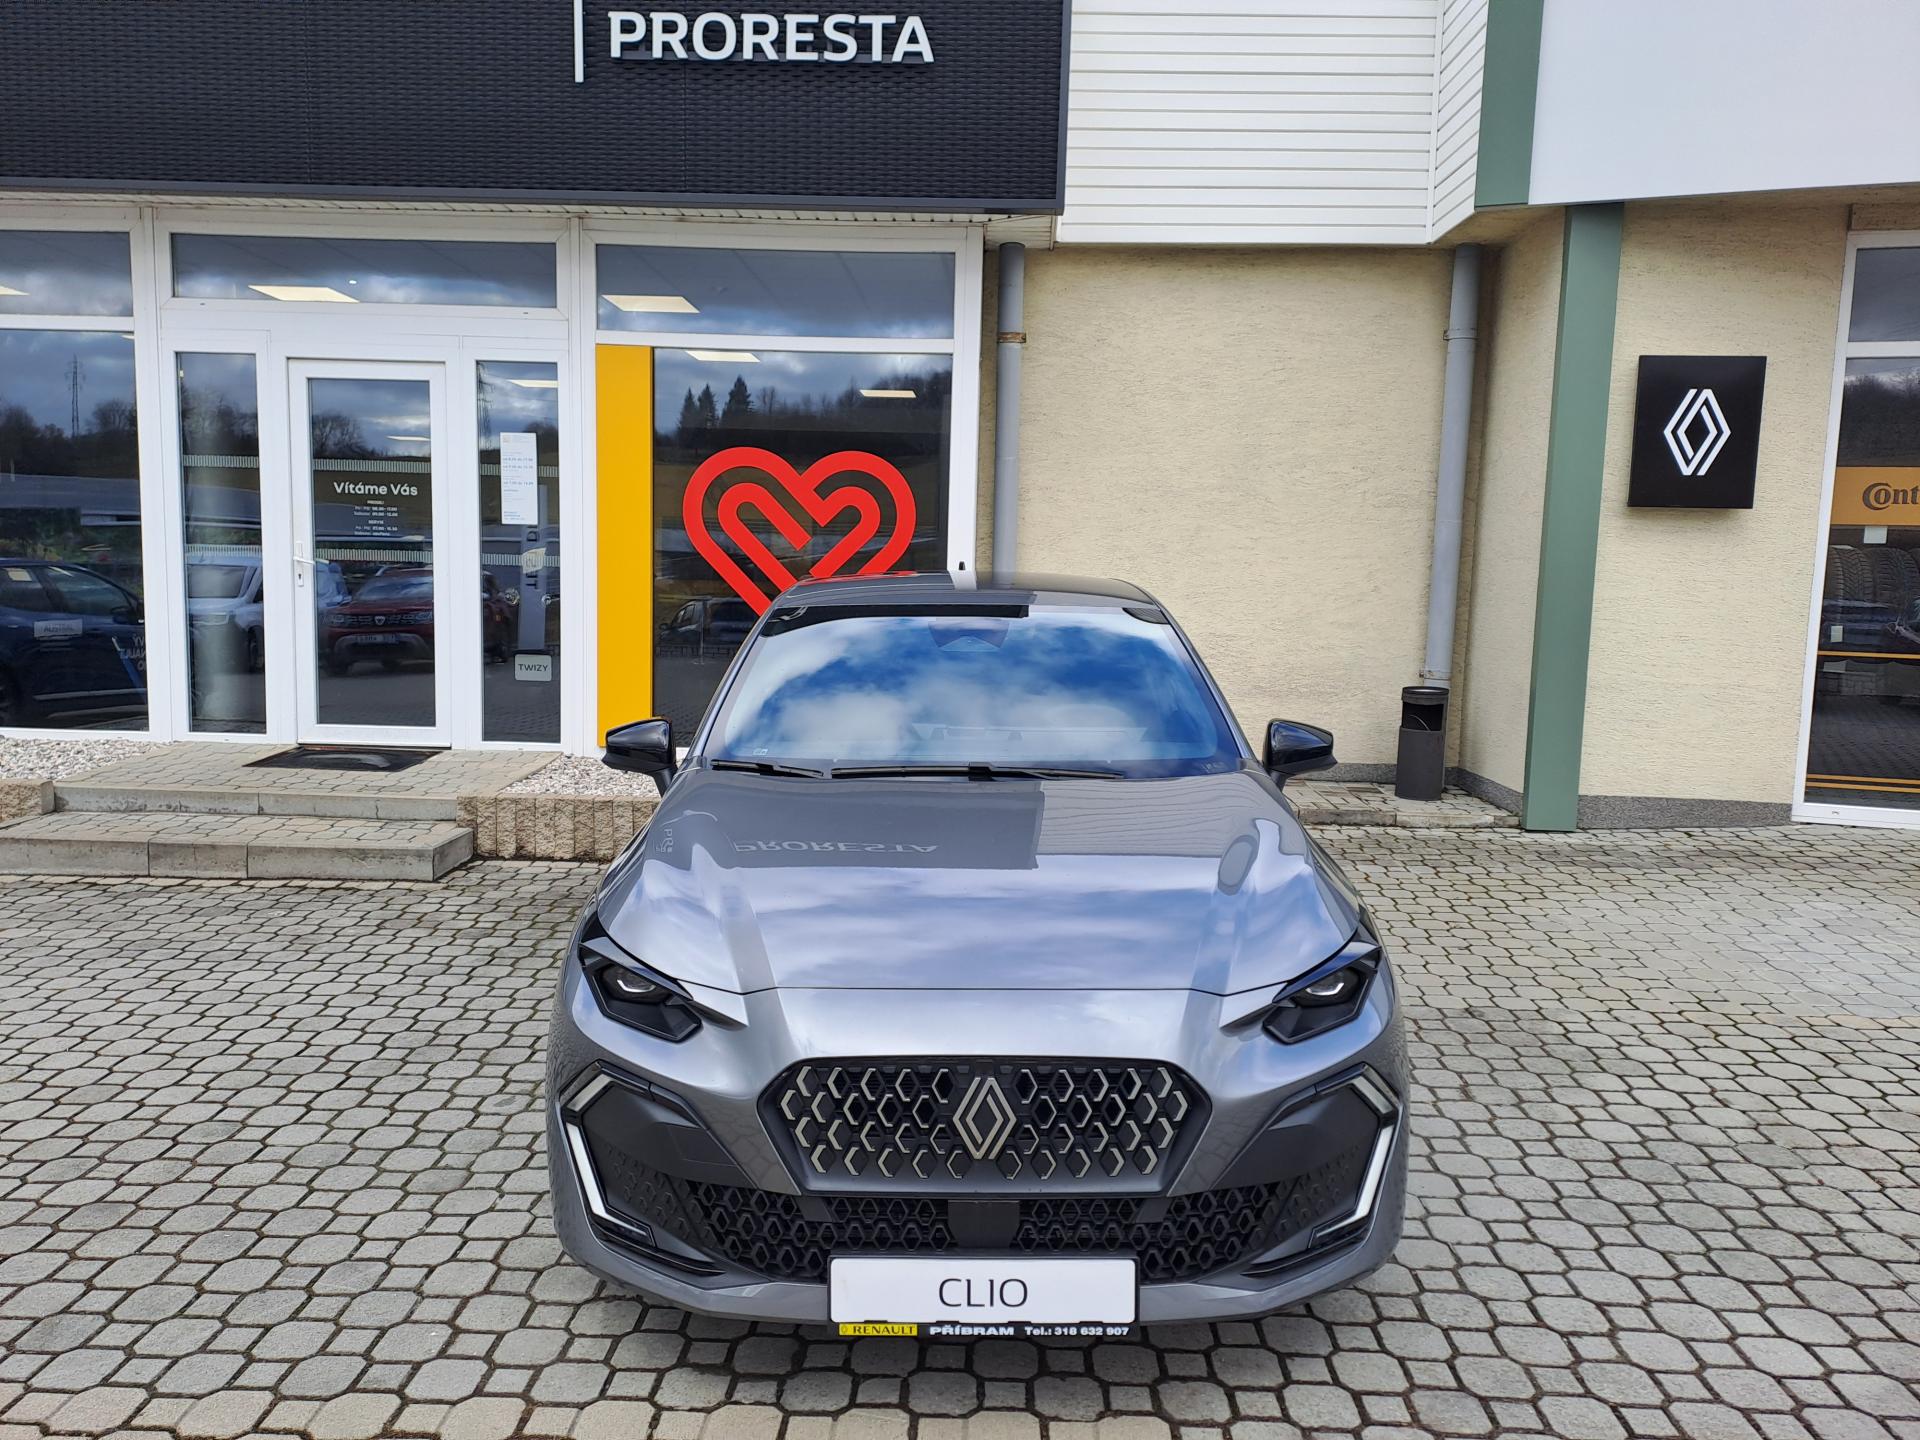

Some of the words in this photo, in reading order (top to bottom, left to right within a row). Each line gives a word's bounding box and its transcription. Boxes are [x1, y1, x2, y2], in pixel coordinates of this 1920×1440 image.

[608, 11, 934, 63] PRORESTA
[333, 481, 387, 495] Vítáme
[390, 483, 418, 496] Vás
[1862, 482, 1920, 510] Cont
[518, 663, 548, 672] TWIZY
[938, 1278, 1028, 1307] CLIO
[853, 1325, 915, 1335] RENAULT
[929, 1324, 1014, 1336] PŘÍBRAM
[1024, 1326, 1052, 1336] Tel.:
[1054, 1326, 1077, 1336] 318
[1080, 1326, 1103, 1336] 632
[1106, 1326, 1129, 1336] 907
